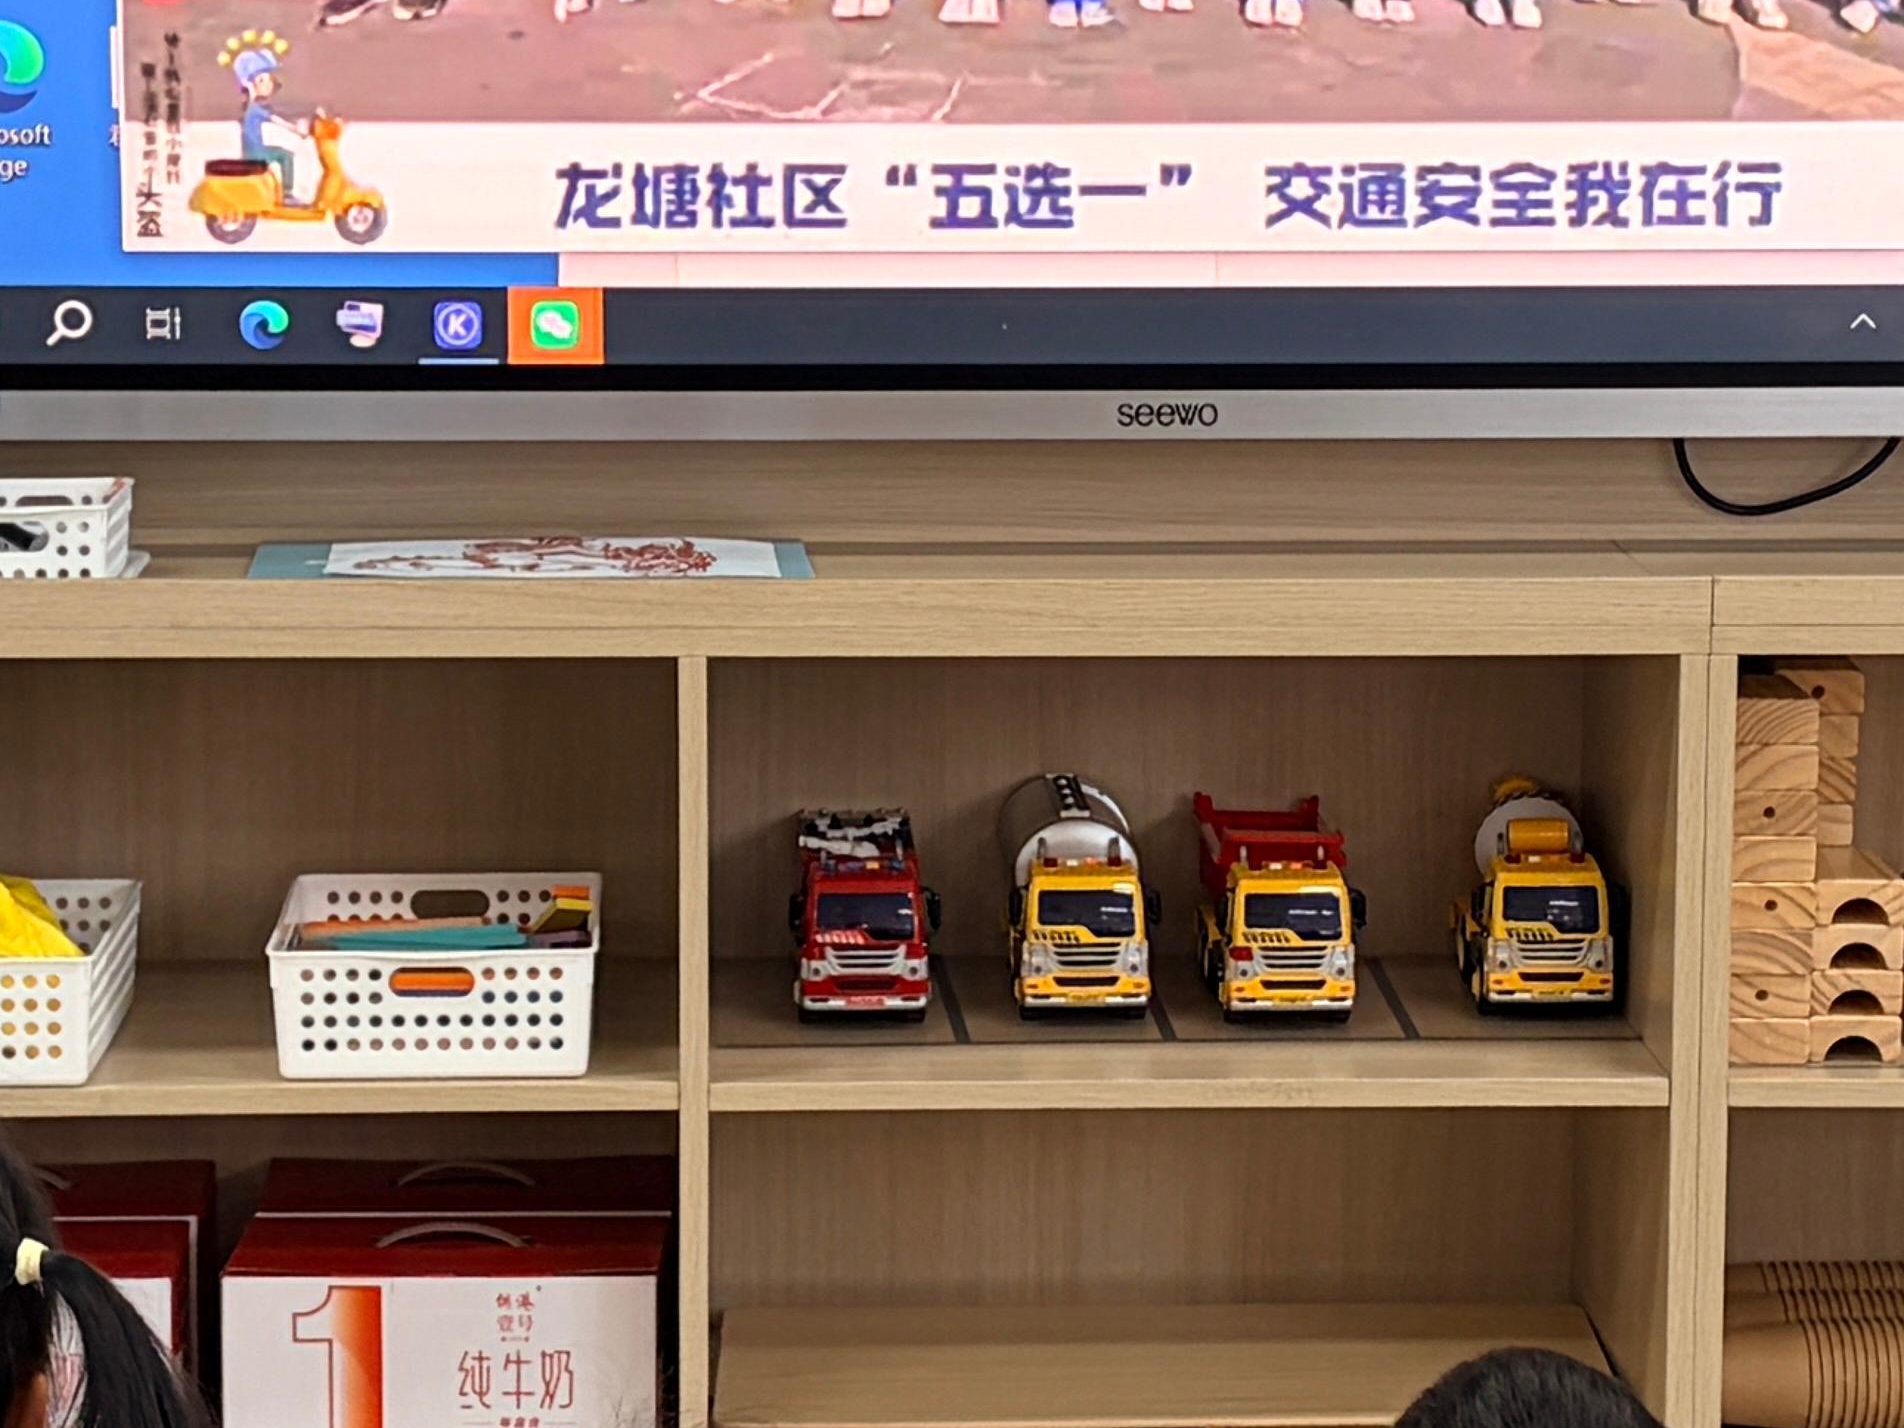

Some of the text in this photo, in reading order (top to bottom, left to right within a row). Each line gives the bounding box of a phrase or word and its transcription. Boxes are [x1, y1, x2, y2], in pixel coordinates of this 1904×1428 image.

[554, 162, 849, 230] 龙塘社区
[1263, 161, 1784, 230] 交通安全我在行
[1117, 402, 1219, 427] seewo
[457, 1349, 574, 1410] 纯牛奶
